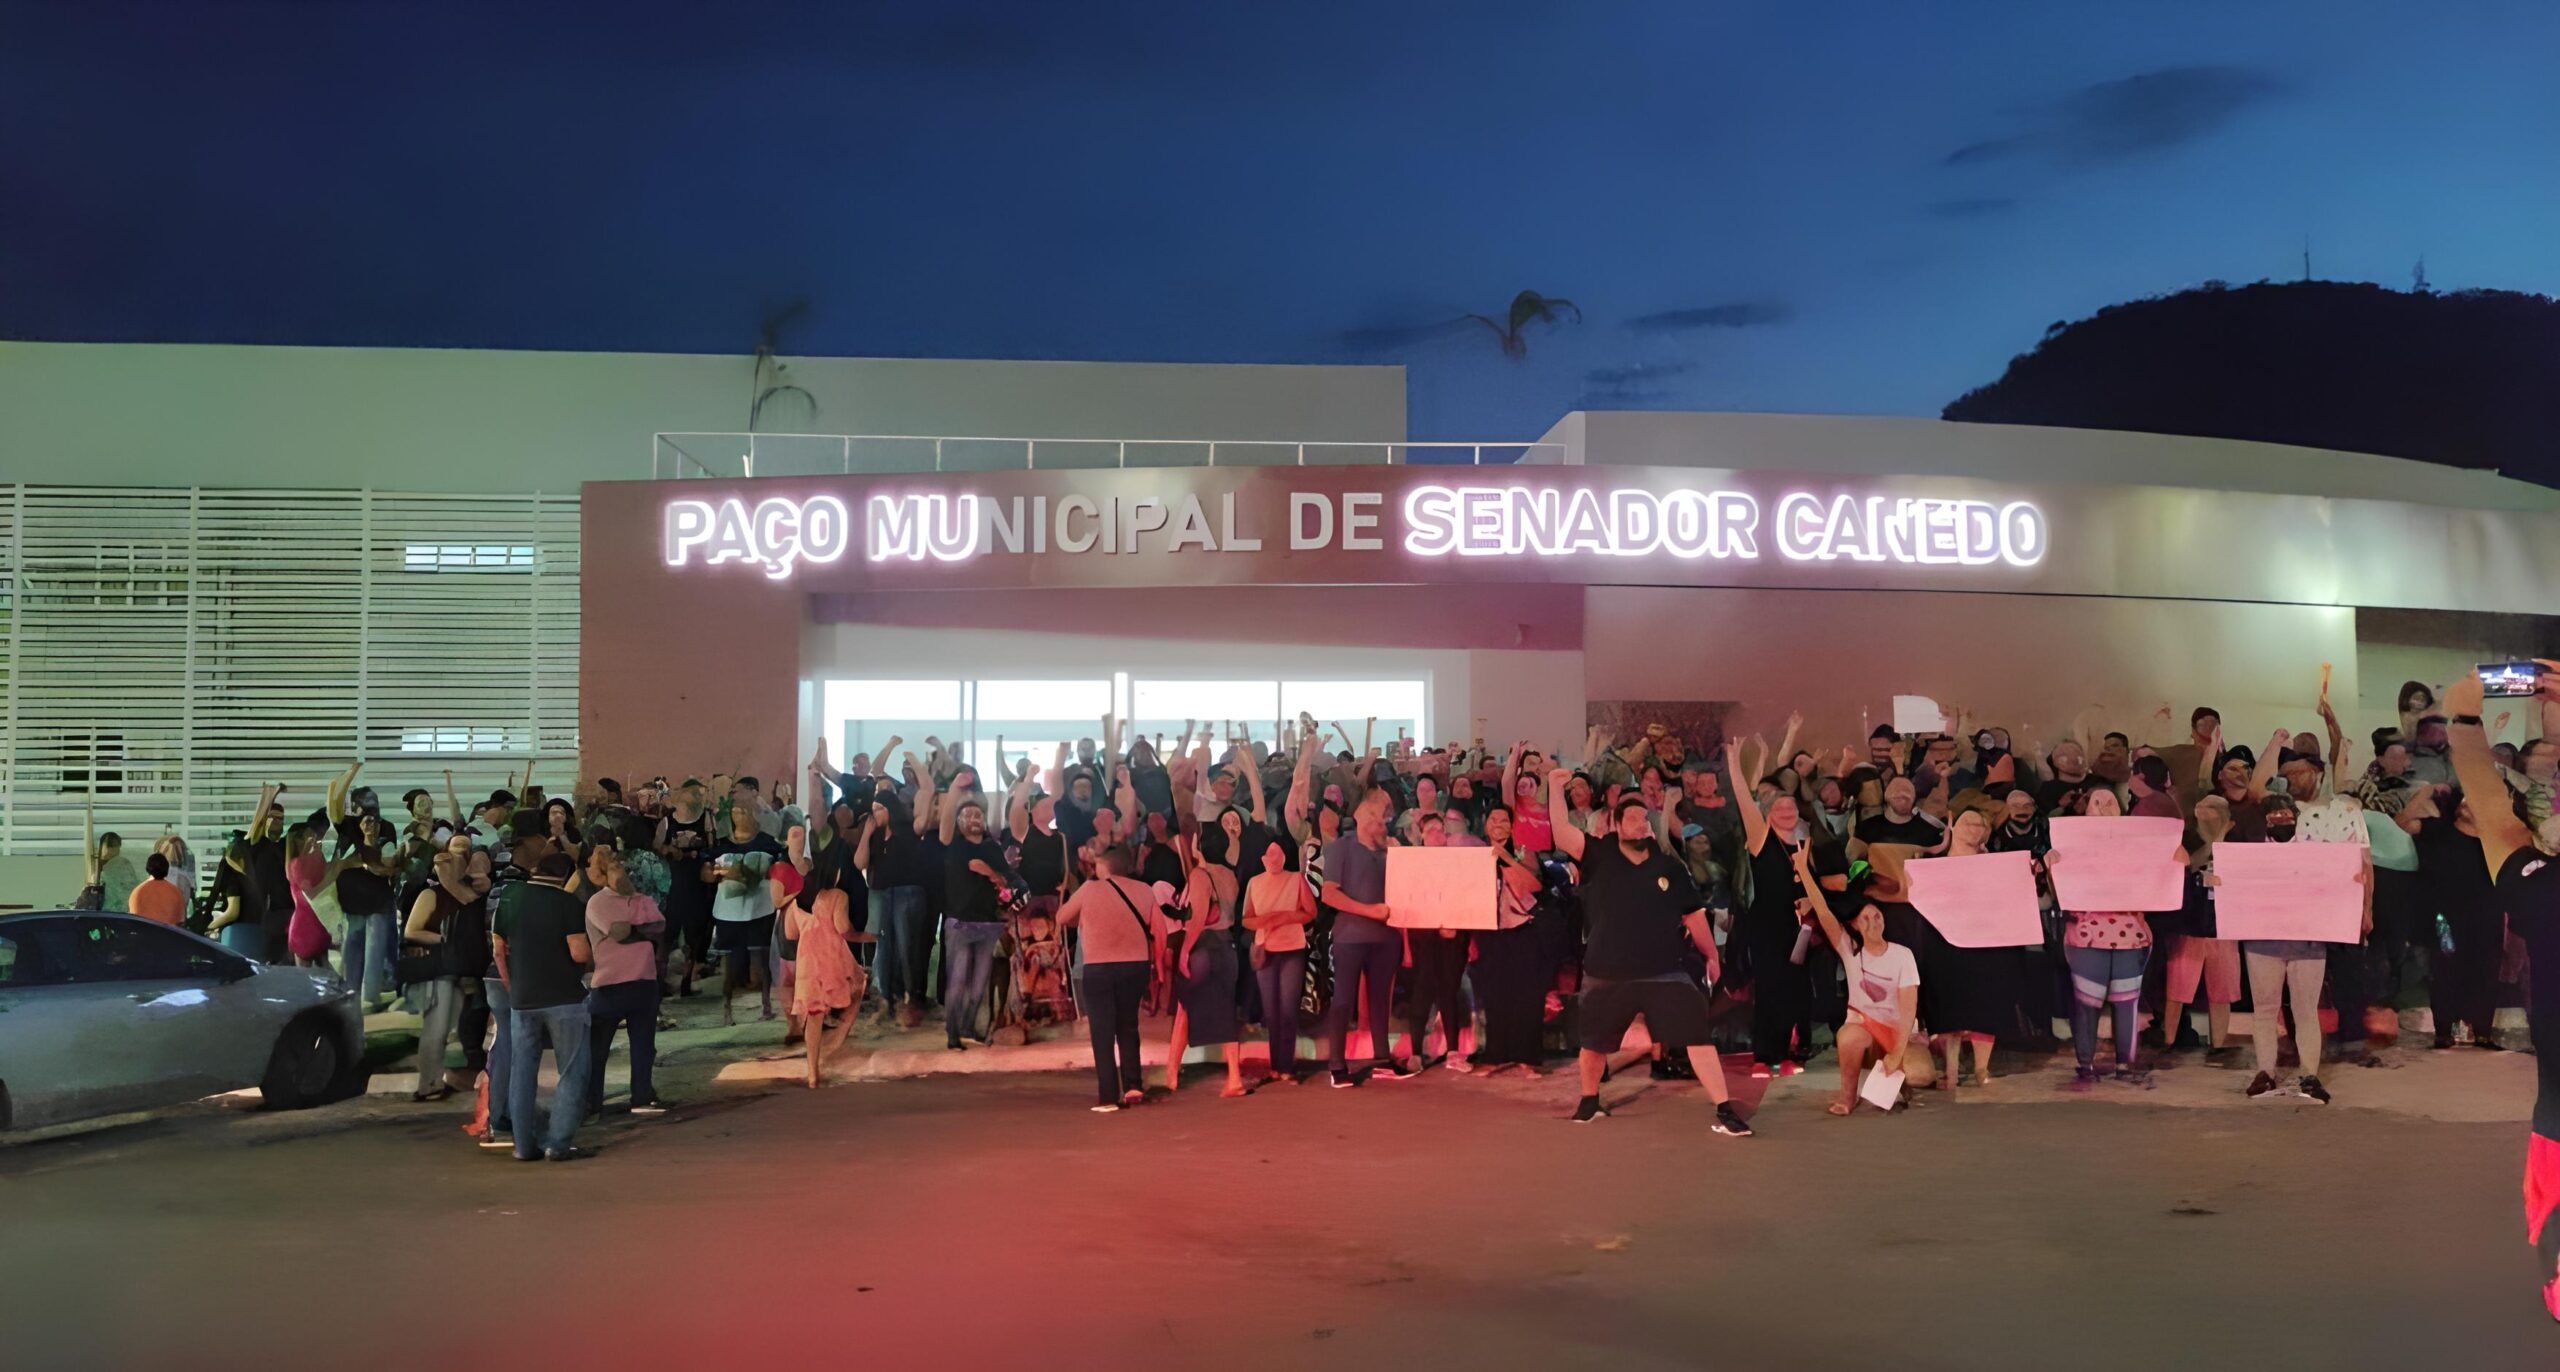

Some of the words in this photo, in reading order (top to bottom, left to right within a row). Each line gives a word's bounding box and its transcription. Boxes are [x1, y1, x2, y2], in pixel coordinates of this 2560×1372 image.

[666, 498, 849, 579] PAÇO
[869, 494, 1263, 556] MUNICIPAL
[1291, 493, 1383, 551] DE
[1404, 486, 1759, 559] SENADOR
[1775, 494, 2045, 566] CANEDO
